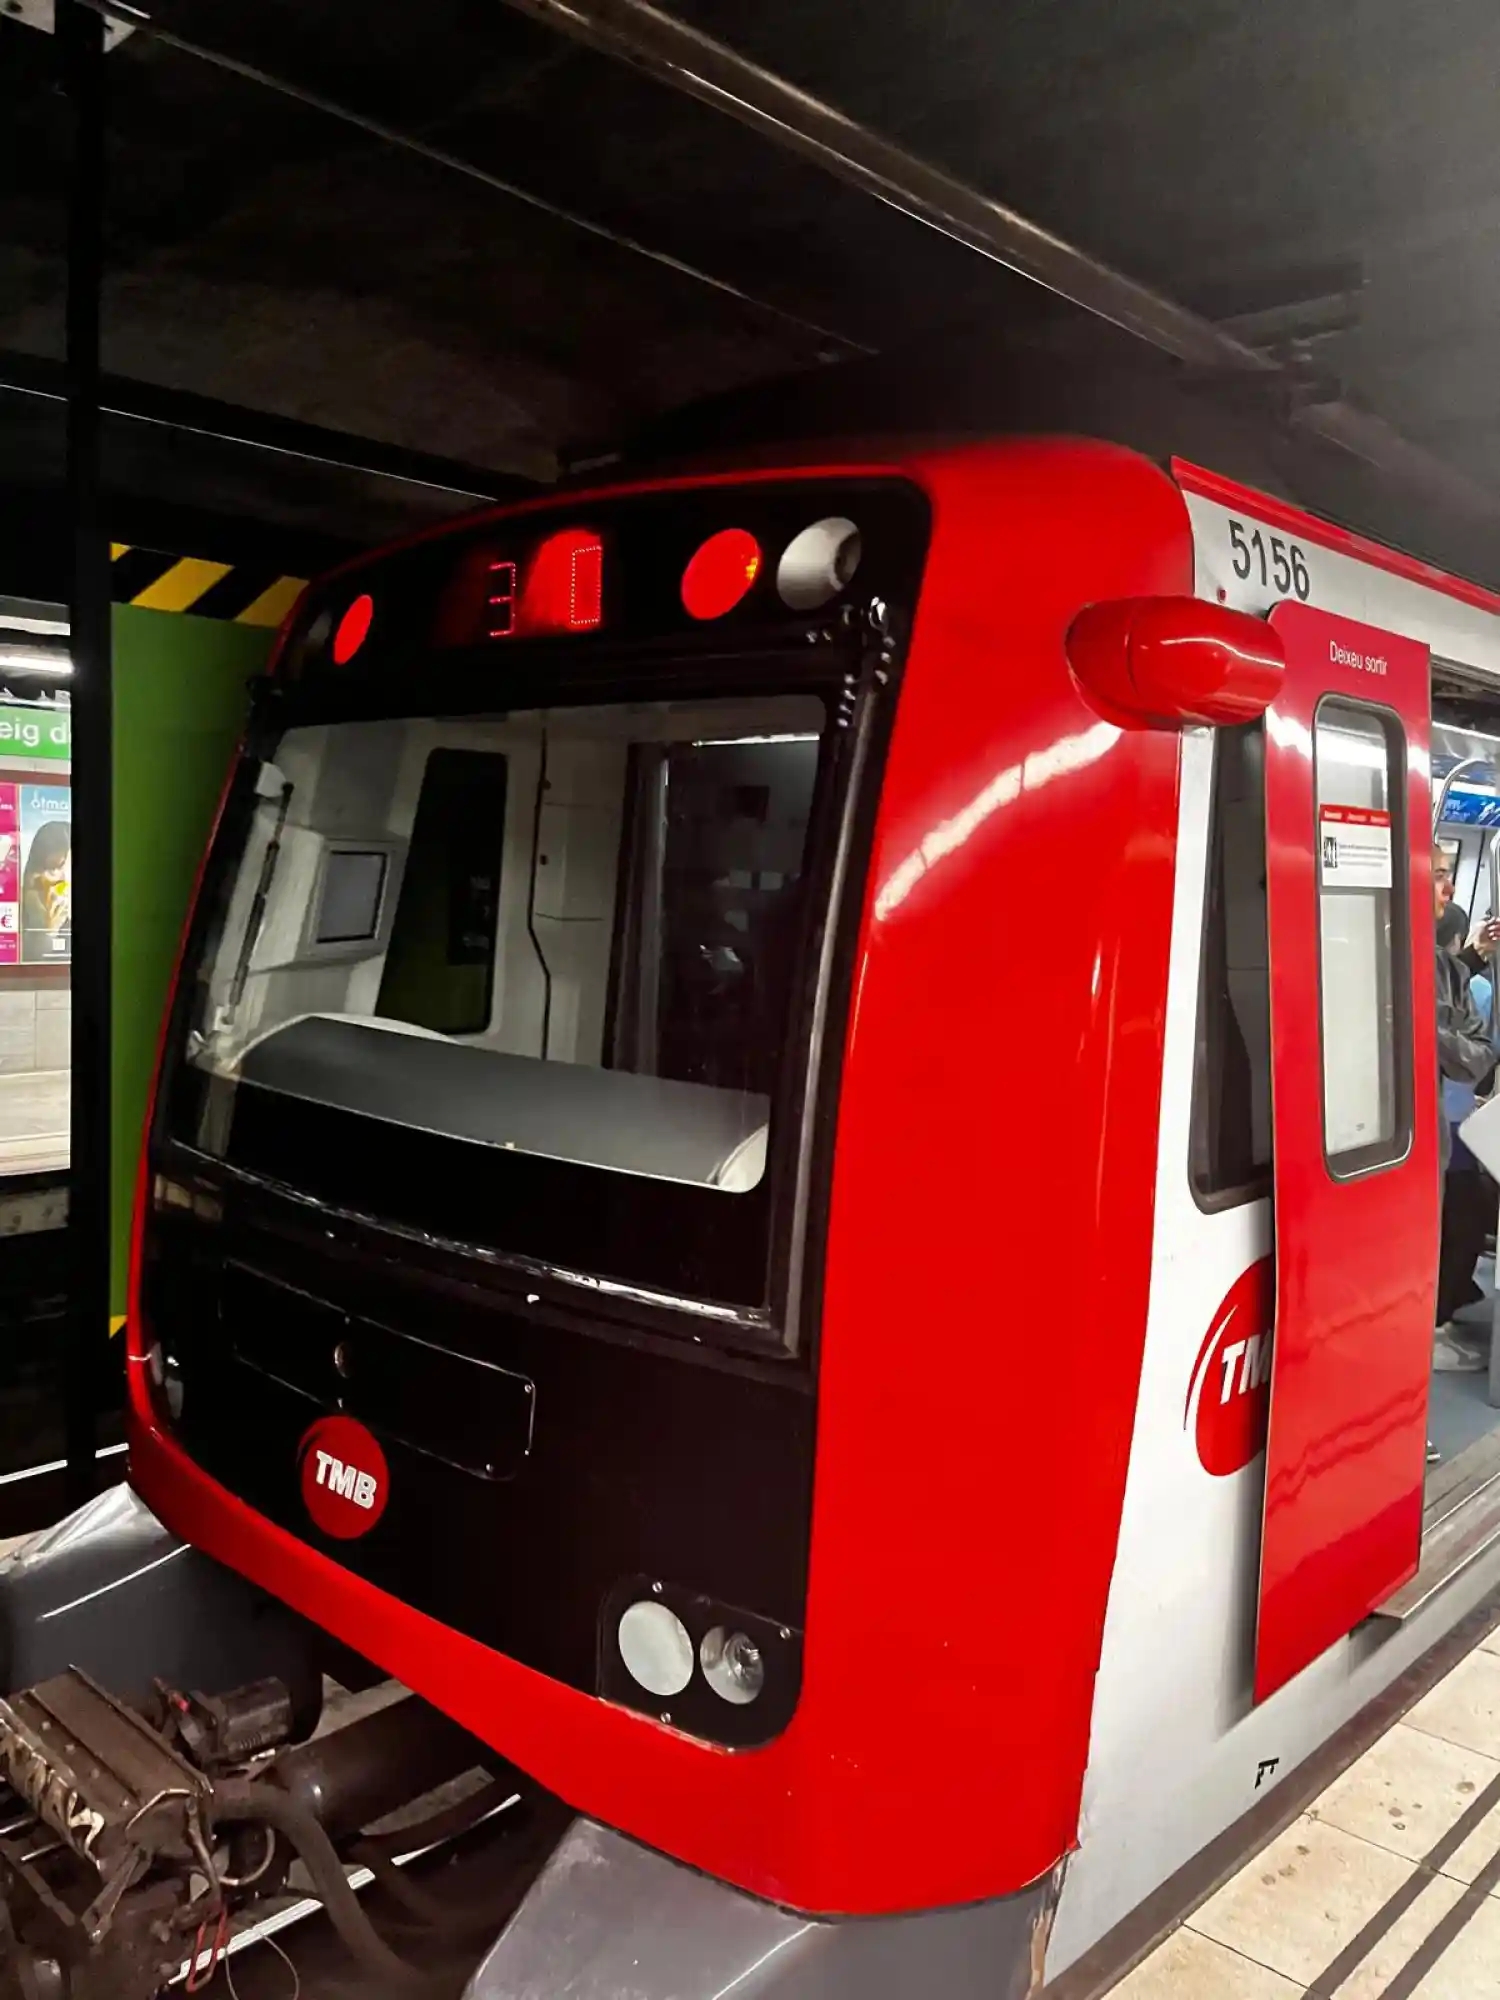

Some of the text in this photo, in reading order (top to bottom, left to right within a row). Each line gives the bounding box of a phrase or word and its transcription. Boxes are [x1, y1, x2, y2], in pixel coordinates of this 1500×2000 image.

[1229, 519, 1310, 601] 5156
[1329, 640, 1387, 675] Deixeu sortir
[316, 1450, 377, 1509] TMB
